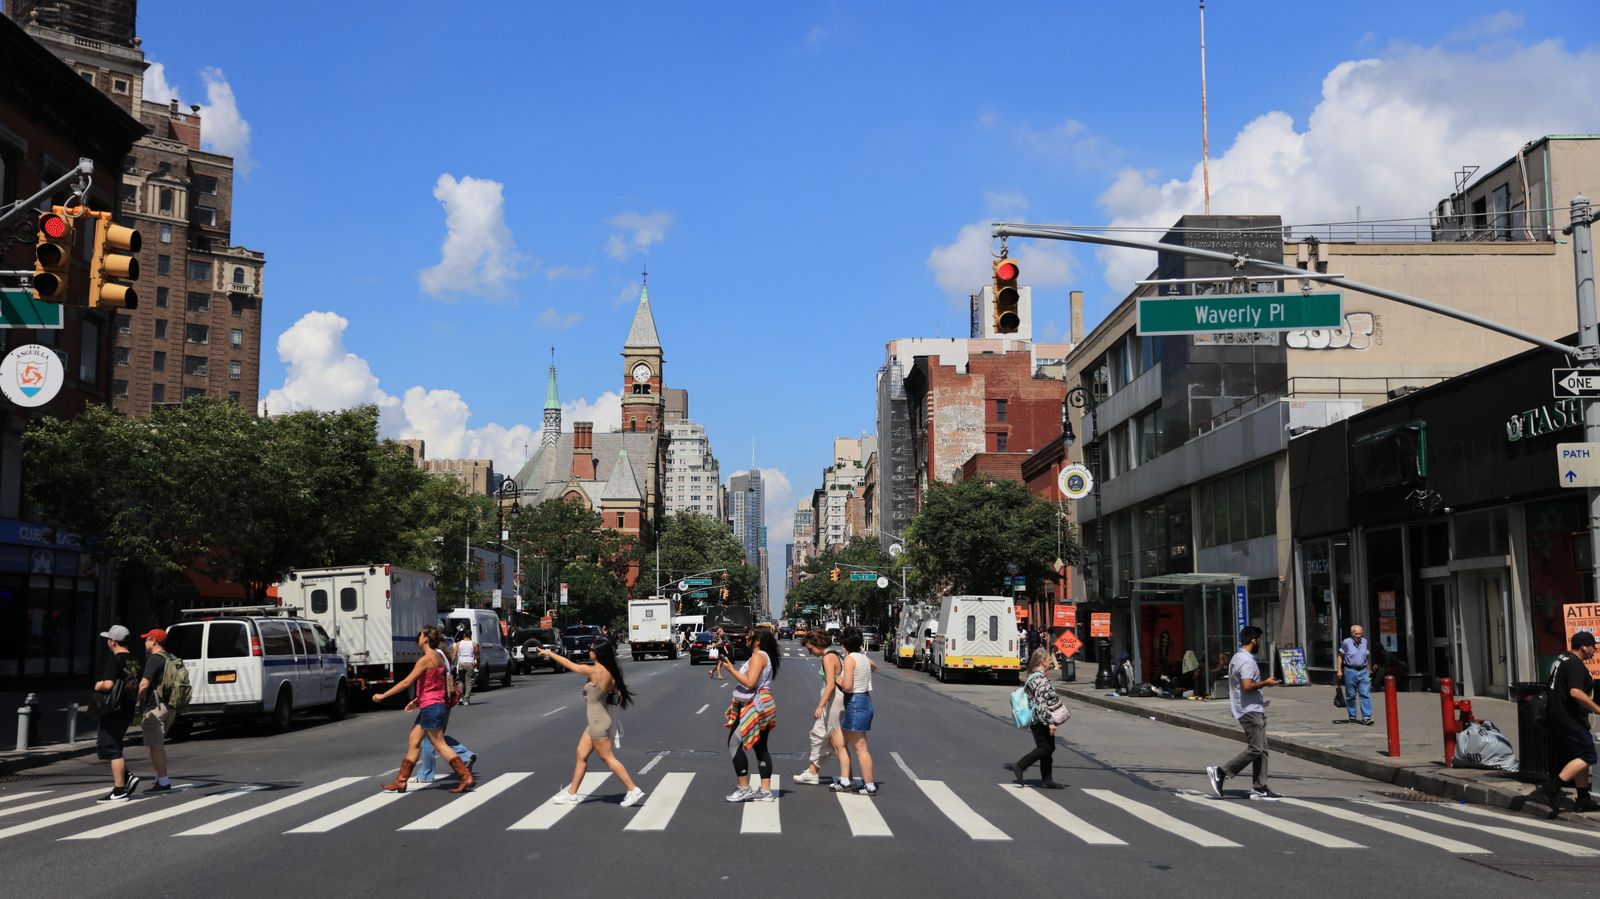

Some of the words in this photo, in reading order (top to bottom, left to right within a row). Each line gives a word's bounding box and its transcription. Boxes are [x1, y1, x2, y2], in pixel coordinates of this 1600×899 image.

[1194, 304, 1262, 327] Waverly
[1269, 303, 1284, 322] Pl
[16, 350, 49, 360] ANGUILLA
[1567, 377, 1592, 389] ONE
[1563, 450, 1590, 459] PATH
